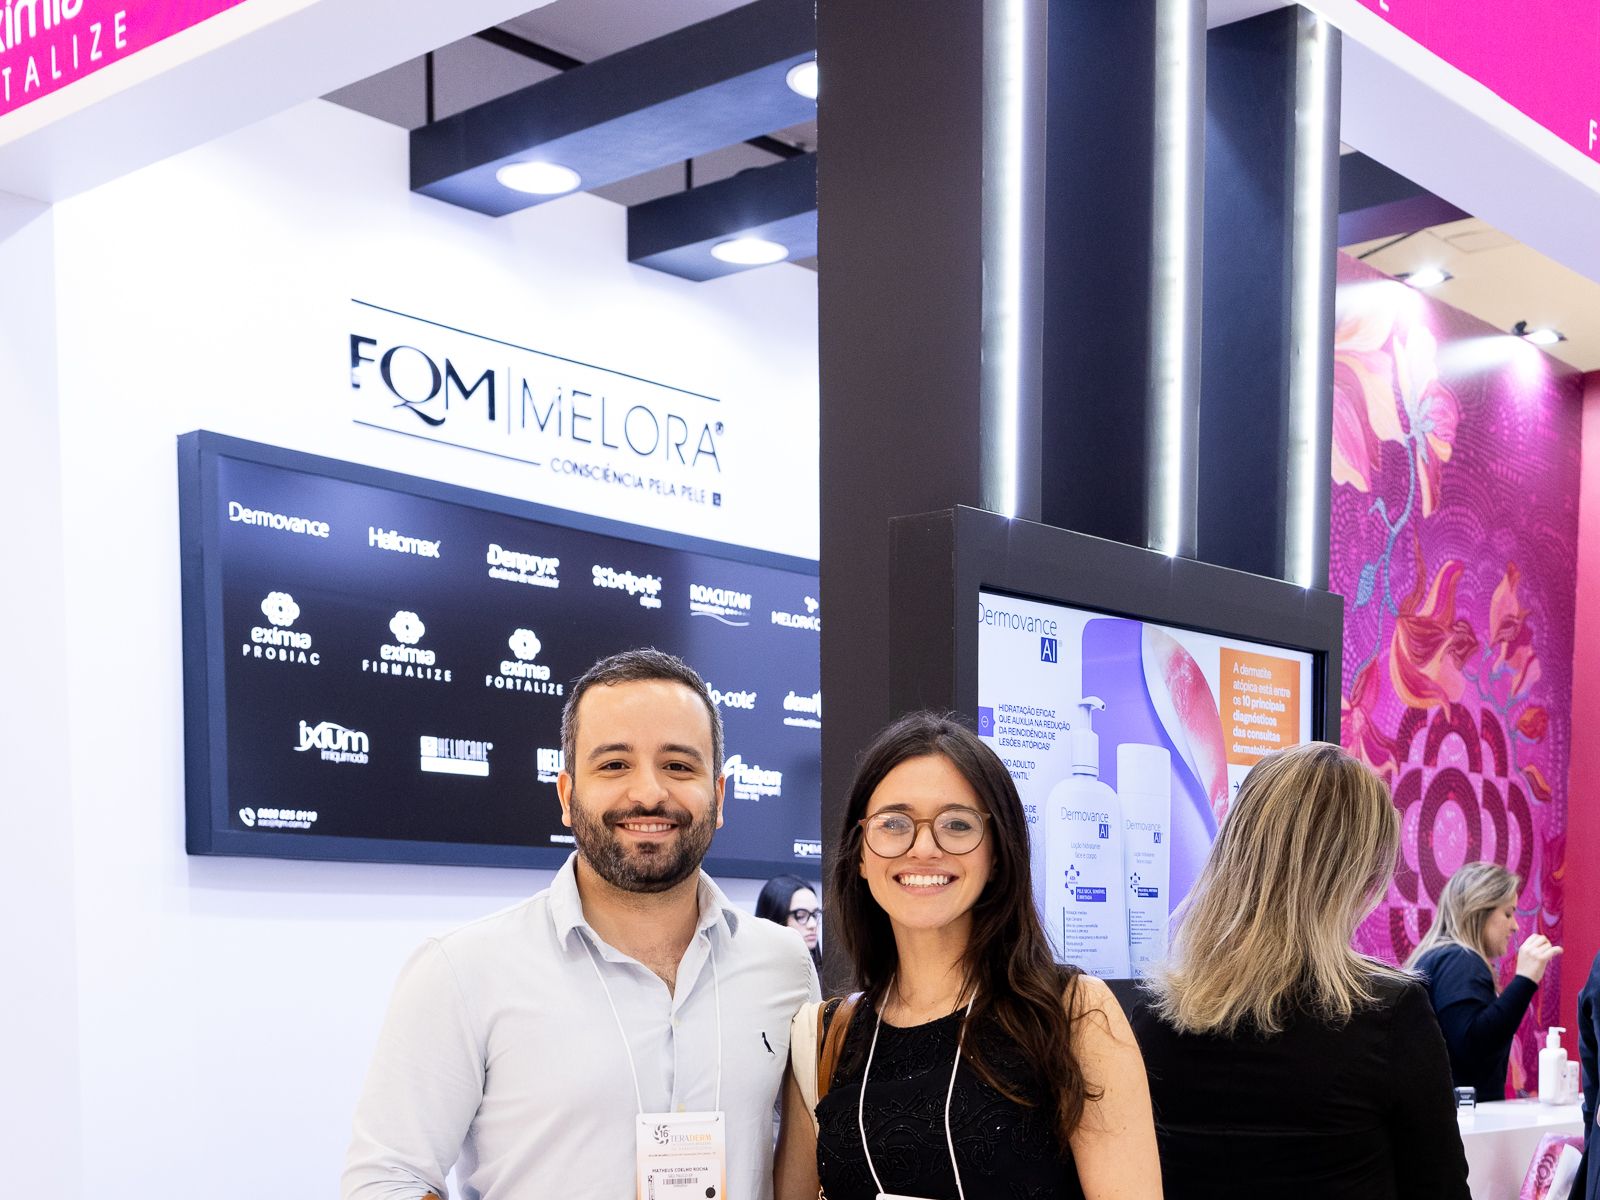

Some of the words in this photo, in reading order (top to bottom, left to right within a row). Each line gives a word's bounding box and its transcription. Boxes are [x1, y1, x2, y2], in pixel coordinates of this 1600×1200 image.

[350, 334, 496, 426] FQM
[522, 377, 721, 473] MELORA
[228, 501, 330, 538] Dermovance
[369, 526, 441, 558] Heliomax
[978, 603, 1057, 636] Dermovance
[242, 643, 320, 666] PROBIAC
[1041, 638, 1057, 663] AI
[362, 659, 452, 682] FIRMALIZE
[1240, 663, 1272, 679] dermatite
[486, 675, 563, 696] FORTALIZE
[998, 703, 1035, 716] HIDRATAÇÃO
[1036, 708, 1056, 718] EFICAZ
[1242, 694, 1250, 707] 10
[1251, 697, 1286, 712] principais
[998, 714, 1011, 724] QUE
[1043, 720, 1071, 731] REDUÇÃO
[1232, 725, 1246, 738] das
[1247, 729, 1280, 742] consultas
[1012, 759, 1035, 769] ADULTO
[1060, 806, 1109, 823] Dermovance
